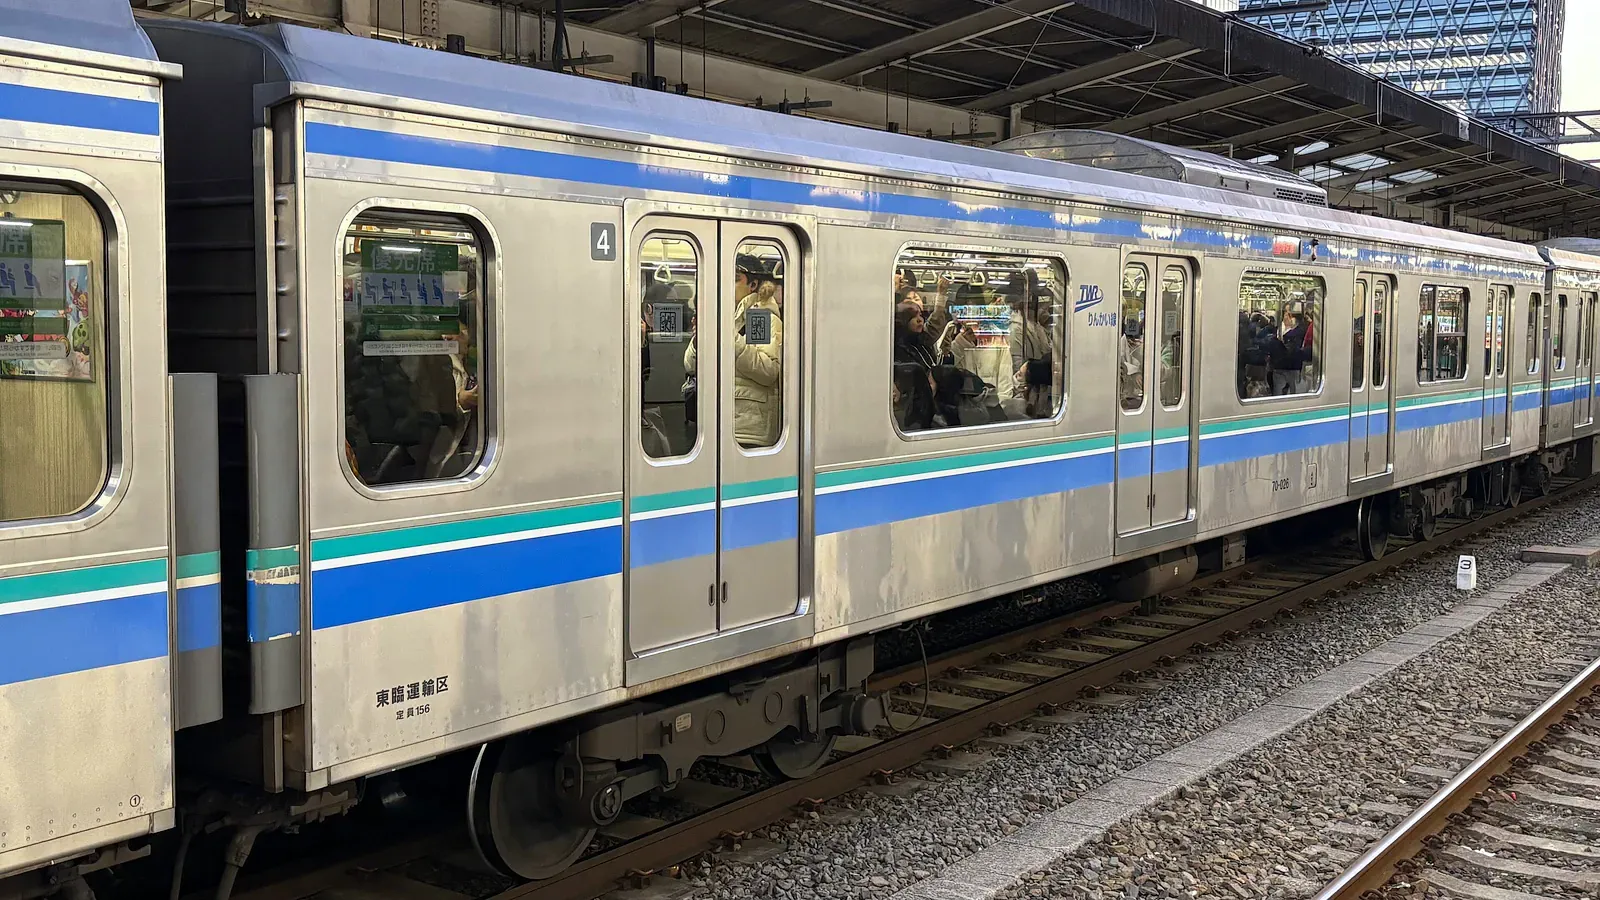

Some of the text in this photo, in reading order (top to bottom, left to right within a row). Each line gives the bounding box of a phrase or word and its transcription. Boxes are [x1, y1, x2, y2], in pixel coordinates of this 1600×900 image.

[596, 229, 610, 255] 4
[1088, 312, 1116, 327] りんかい線
[1272, 478, 1289, 492] 70-026
[1460, 560, 1472, 569] 3
[376, 675, 449, 708] 東臨運輸区
